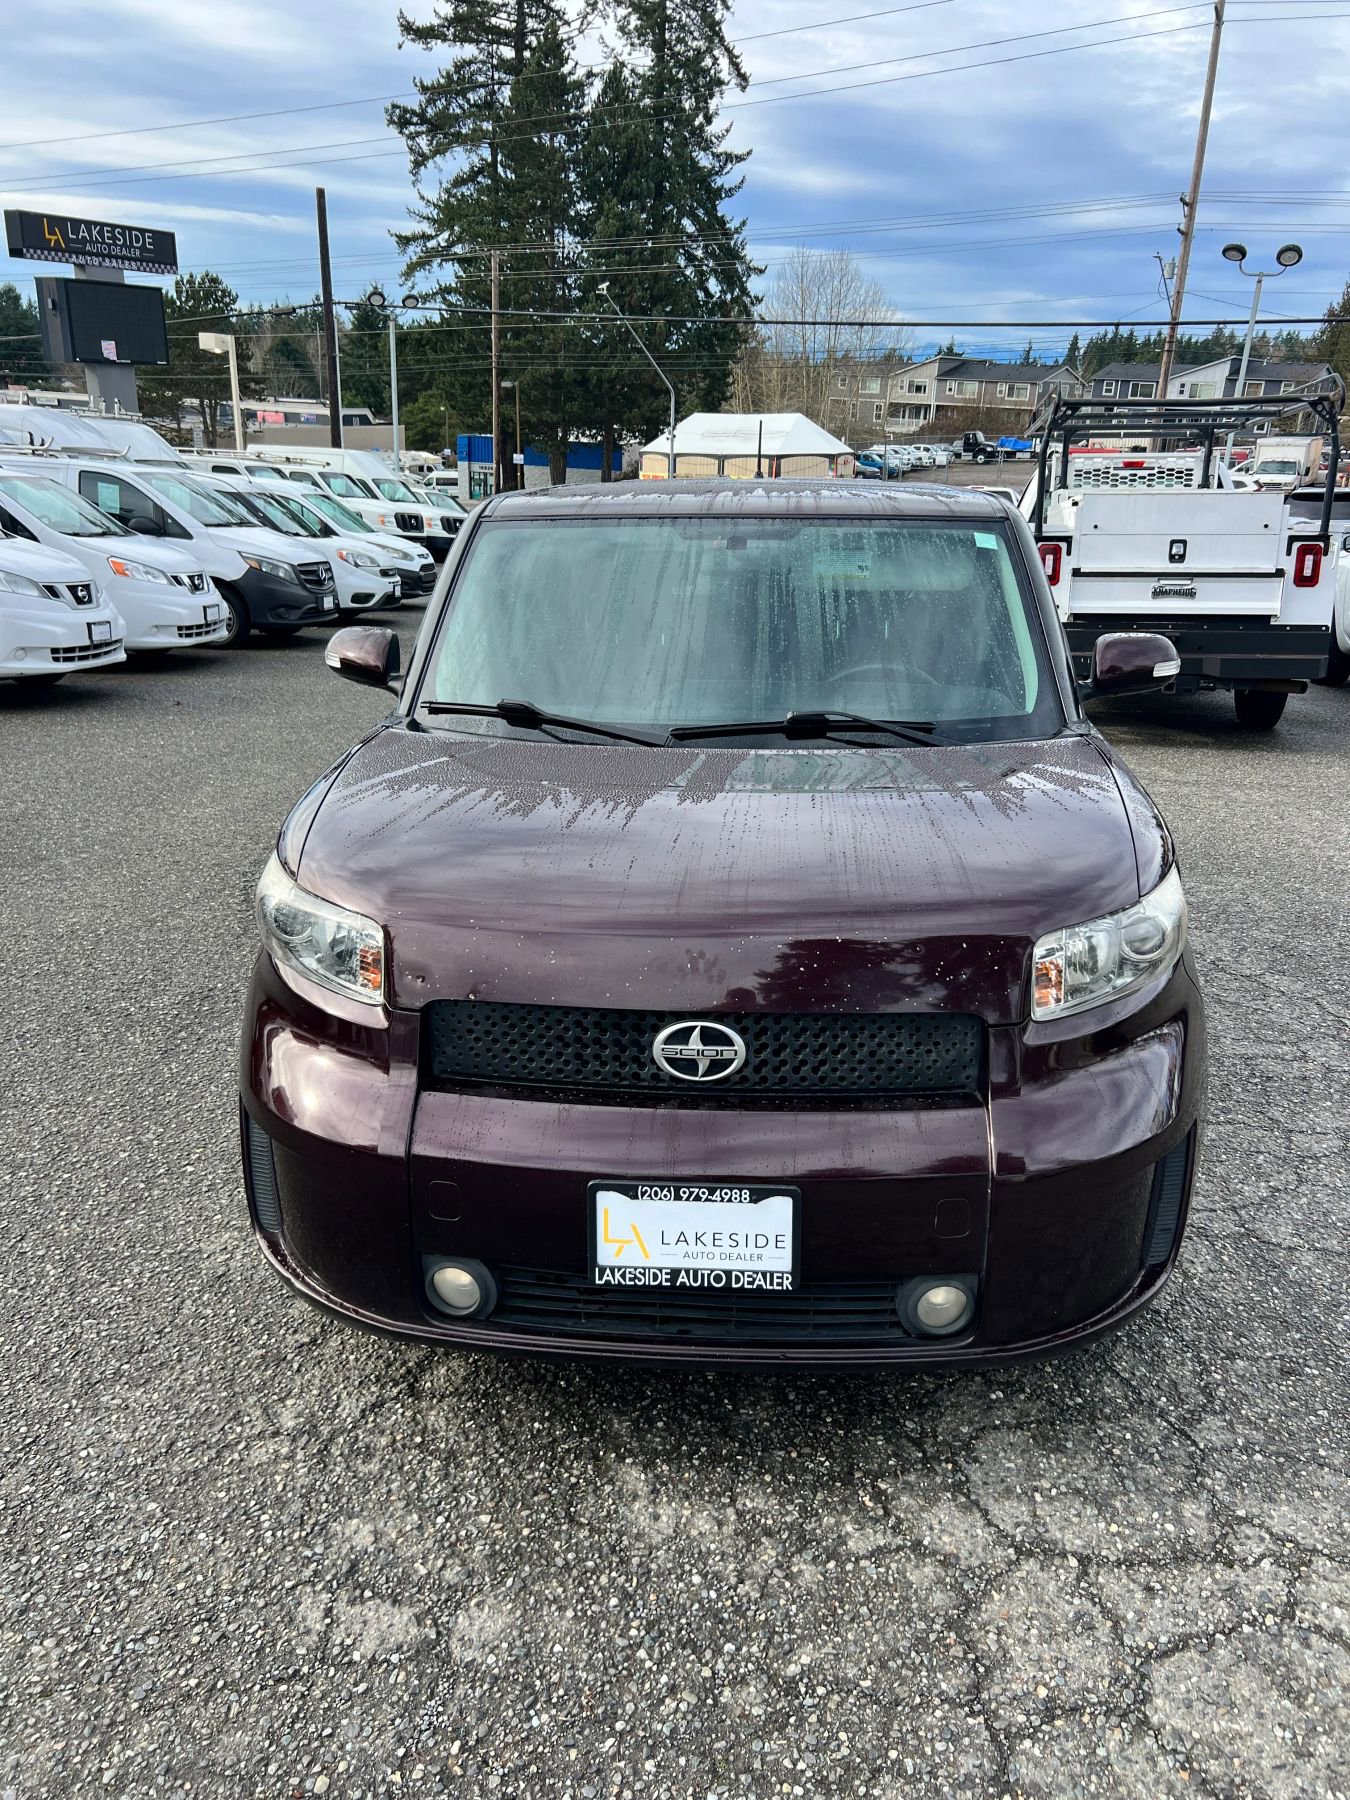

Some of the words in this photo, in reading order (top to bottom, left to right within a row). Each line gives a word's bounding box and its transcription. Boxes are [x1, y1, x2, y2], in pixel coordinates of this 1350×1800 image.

[67, 221, 154, 249] LAKESIDE
[85, 242, 109, 254] AUTO
[110, 245, 141, 257] DEALER
[71, 255, 99, 265] AUTO
[104, 258, 137, 270] SALES
[1152, 586, 1197, 598] KNAPHEIDE
[661, 1047, 738, 1058] SCION
[637, 1185, 675, 1201] (206)
[680, 1187, 750, 1203] 979-4988
[661, 1230, 787, 1250] LAKESIDE
[683, 1251, 716, 1261] AUTO
[719, 1252, 764, 1262] DEALER
[595, 1267, 671, 1286] LAKESIDE
[676, 1269, 726, 1288] AUTO
[732, 1271, 793, 1291] DEALER
